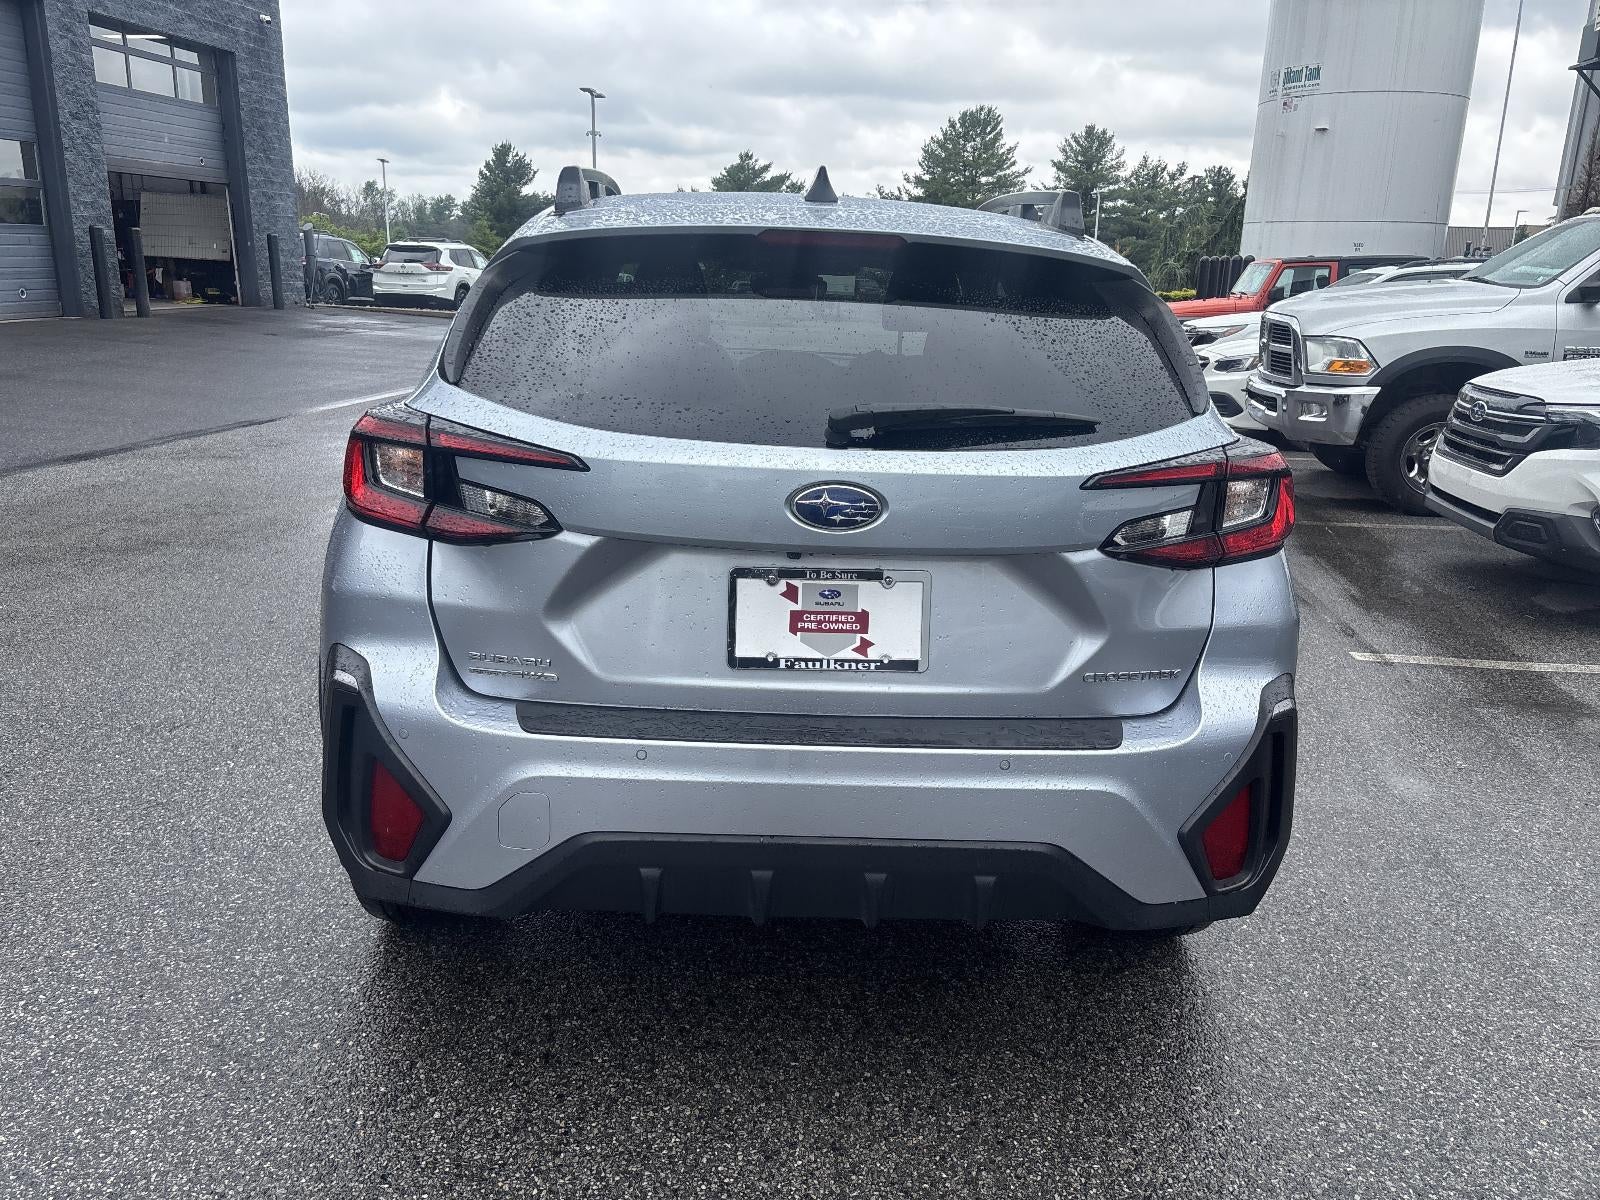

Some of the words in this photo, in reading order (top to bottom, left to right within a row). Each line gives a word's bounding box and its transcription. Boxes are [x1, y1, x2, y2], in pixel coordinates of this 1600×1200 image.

[1303, 64, 1322, 84] Tank
[805, 570, 817, 578] To
[820, 570, 833, 579] Be
[834, 571, 858, 580] Sure
[803, 614, 856, 622] CERTIFIED
[797, 622, 861, 630] PRE-OWNED
[468, 651, 552, 668] SUBARU
[778, 658, 881, 670] Faulkner
